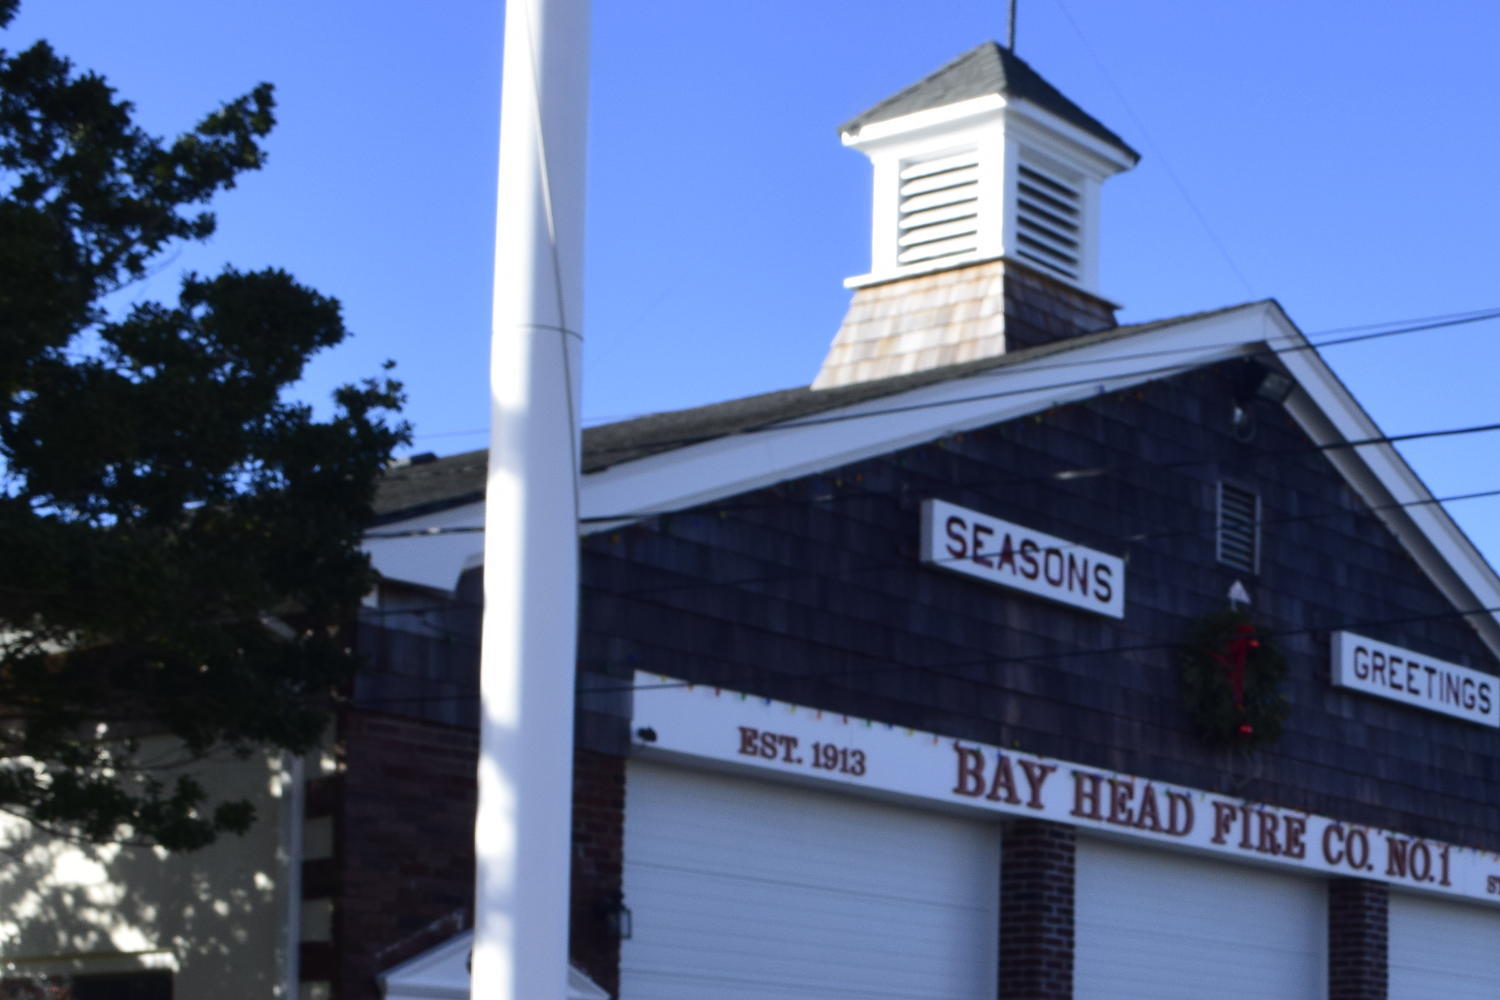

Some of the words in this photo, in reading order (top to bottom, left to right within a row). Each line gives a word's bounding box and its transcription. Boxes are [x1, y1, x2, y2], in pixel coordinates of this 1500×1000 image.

[944, 515, 1112, 603] SEASONS
[1353, 645, 1493, 716] GREETINGS
[738, 726, 803, 764] EST.
[812, 742, 866, 776] 1913
[952, 741, 1056, 810] BAY
[1070, 770, 1194, 837] HEAD
[1211, 802, 1306, 860] FIRE
[1322, 824, 1373, 871] CO.
